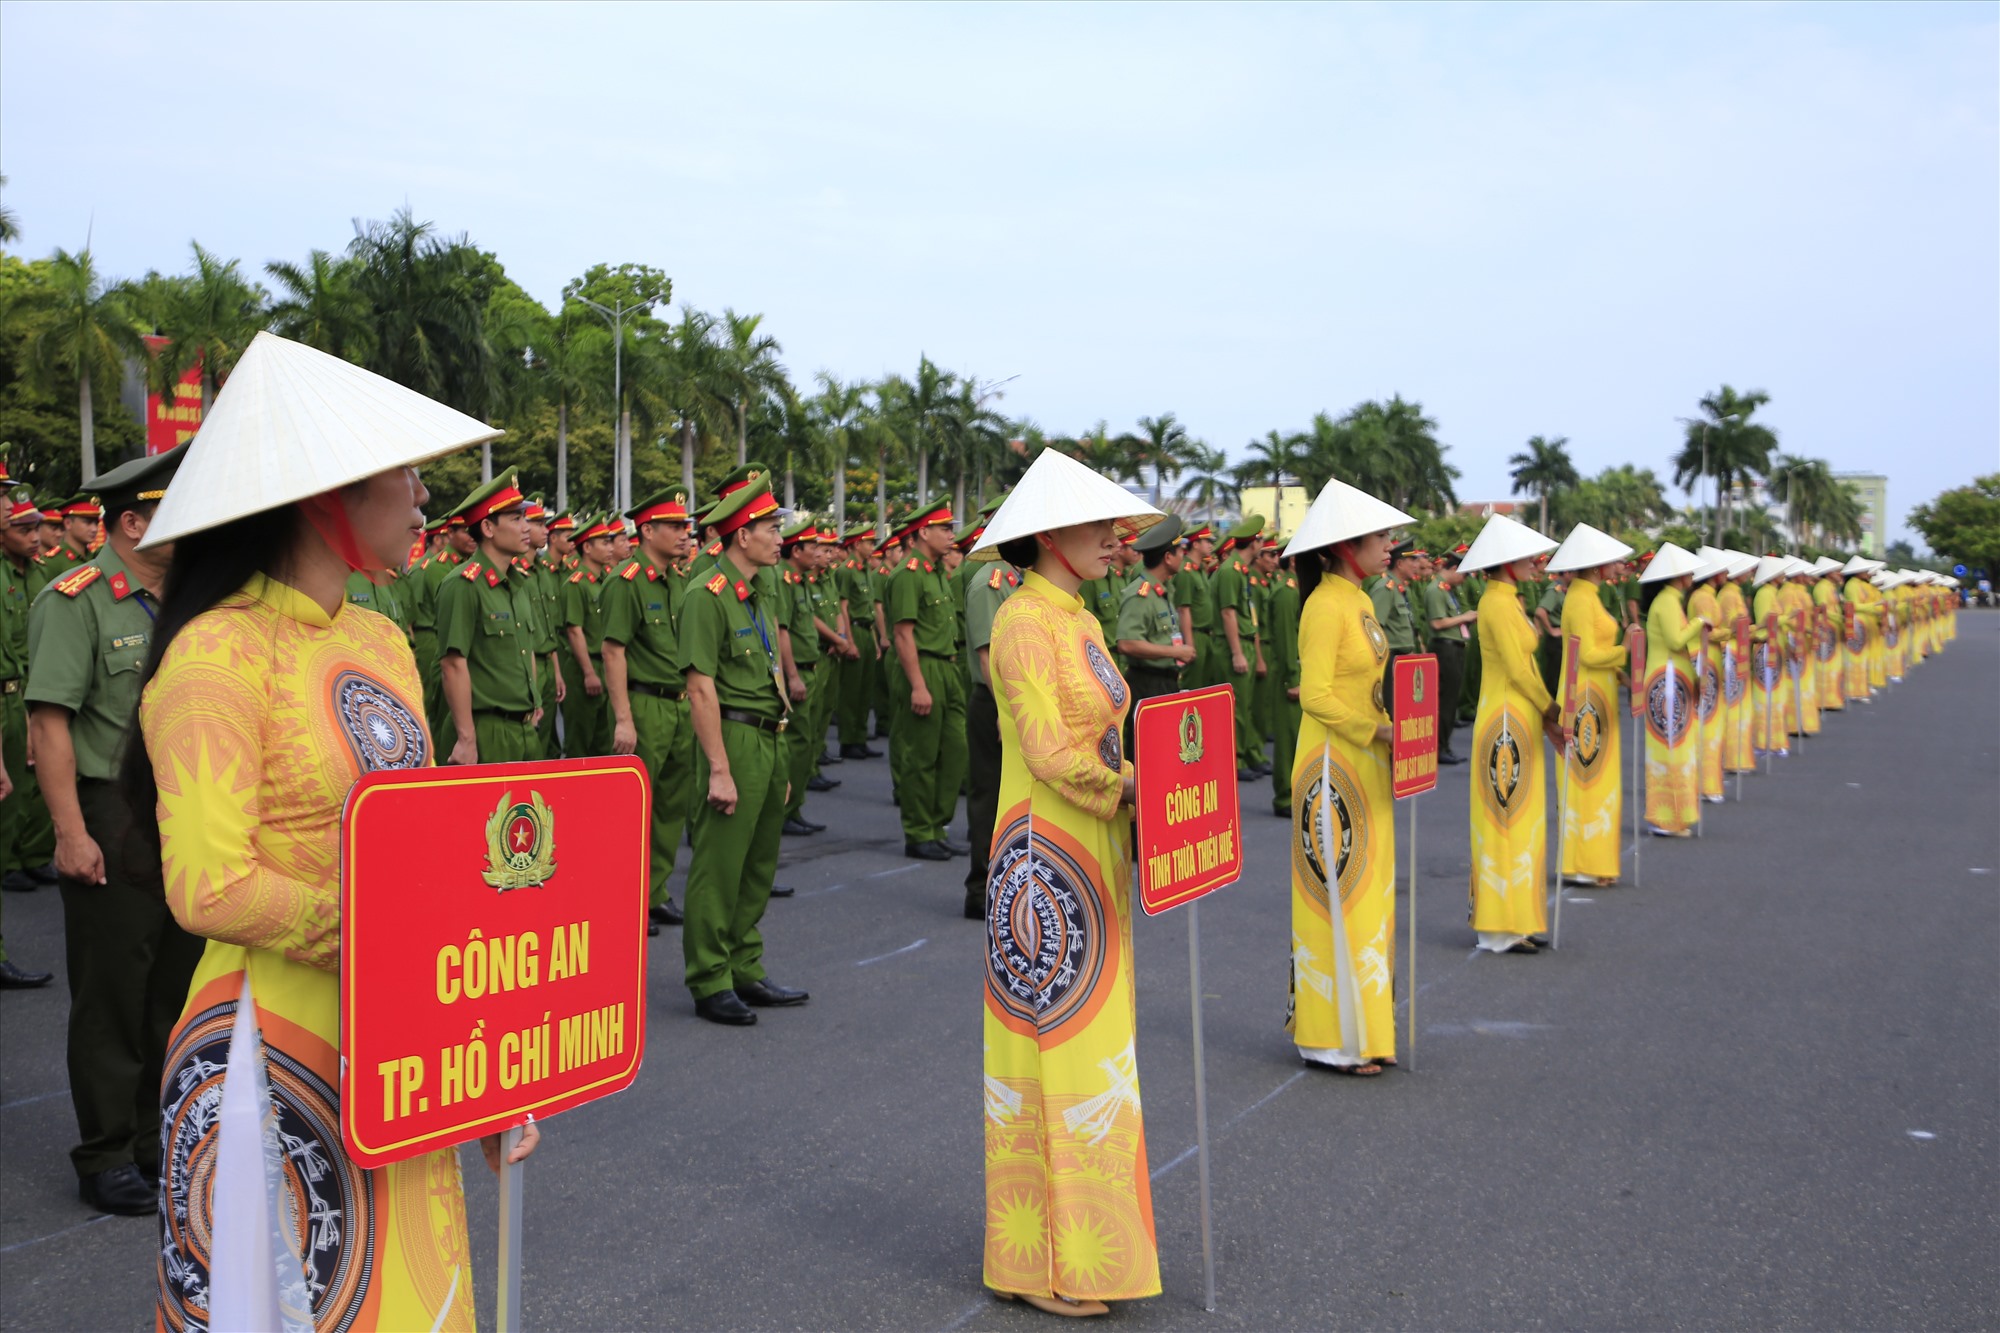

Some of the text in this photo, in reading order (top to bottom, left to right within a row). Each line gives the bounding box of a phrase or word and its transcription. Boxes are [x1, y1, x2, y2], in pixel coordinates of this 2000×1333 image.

[1166, 780, 1218, 825] CÔNG AN
[1148, 845, 1170, 891] TỈNH
[1172, 839, 1196, 883] THỪA
[1196, 831, 1219, 874] THIÊN
[436, 920, 589, 1004] CÔNG AN
[378, 1002, 624, 1122] TP. HỒ CHÍ MINH
